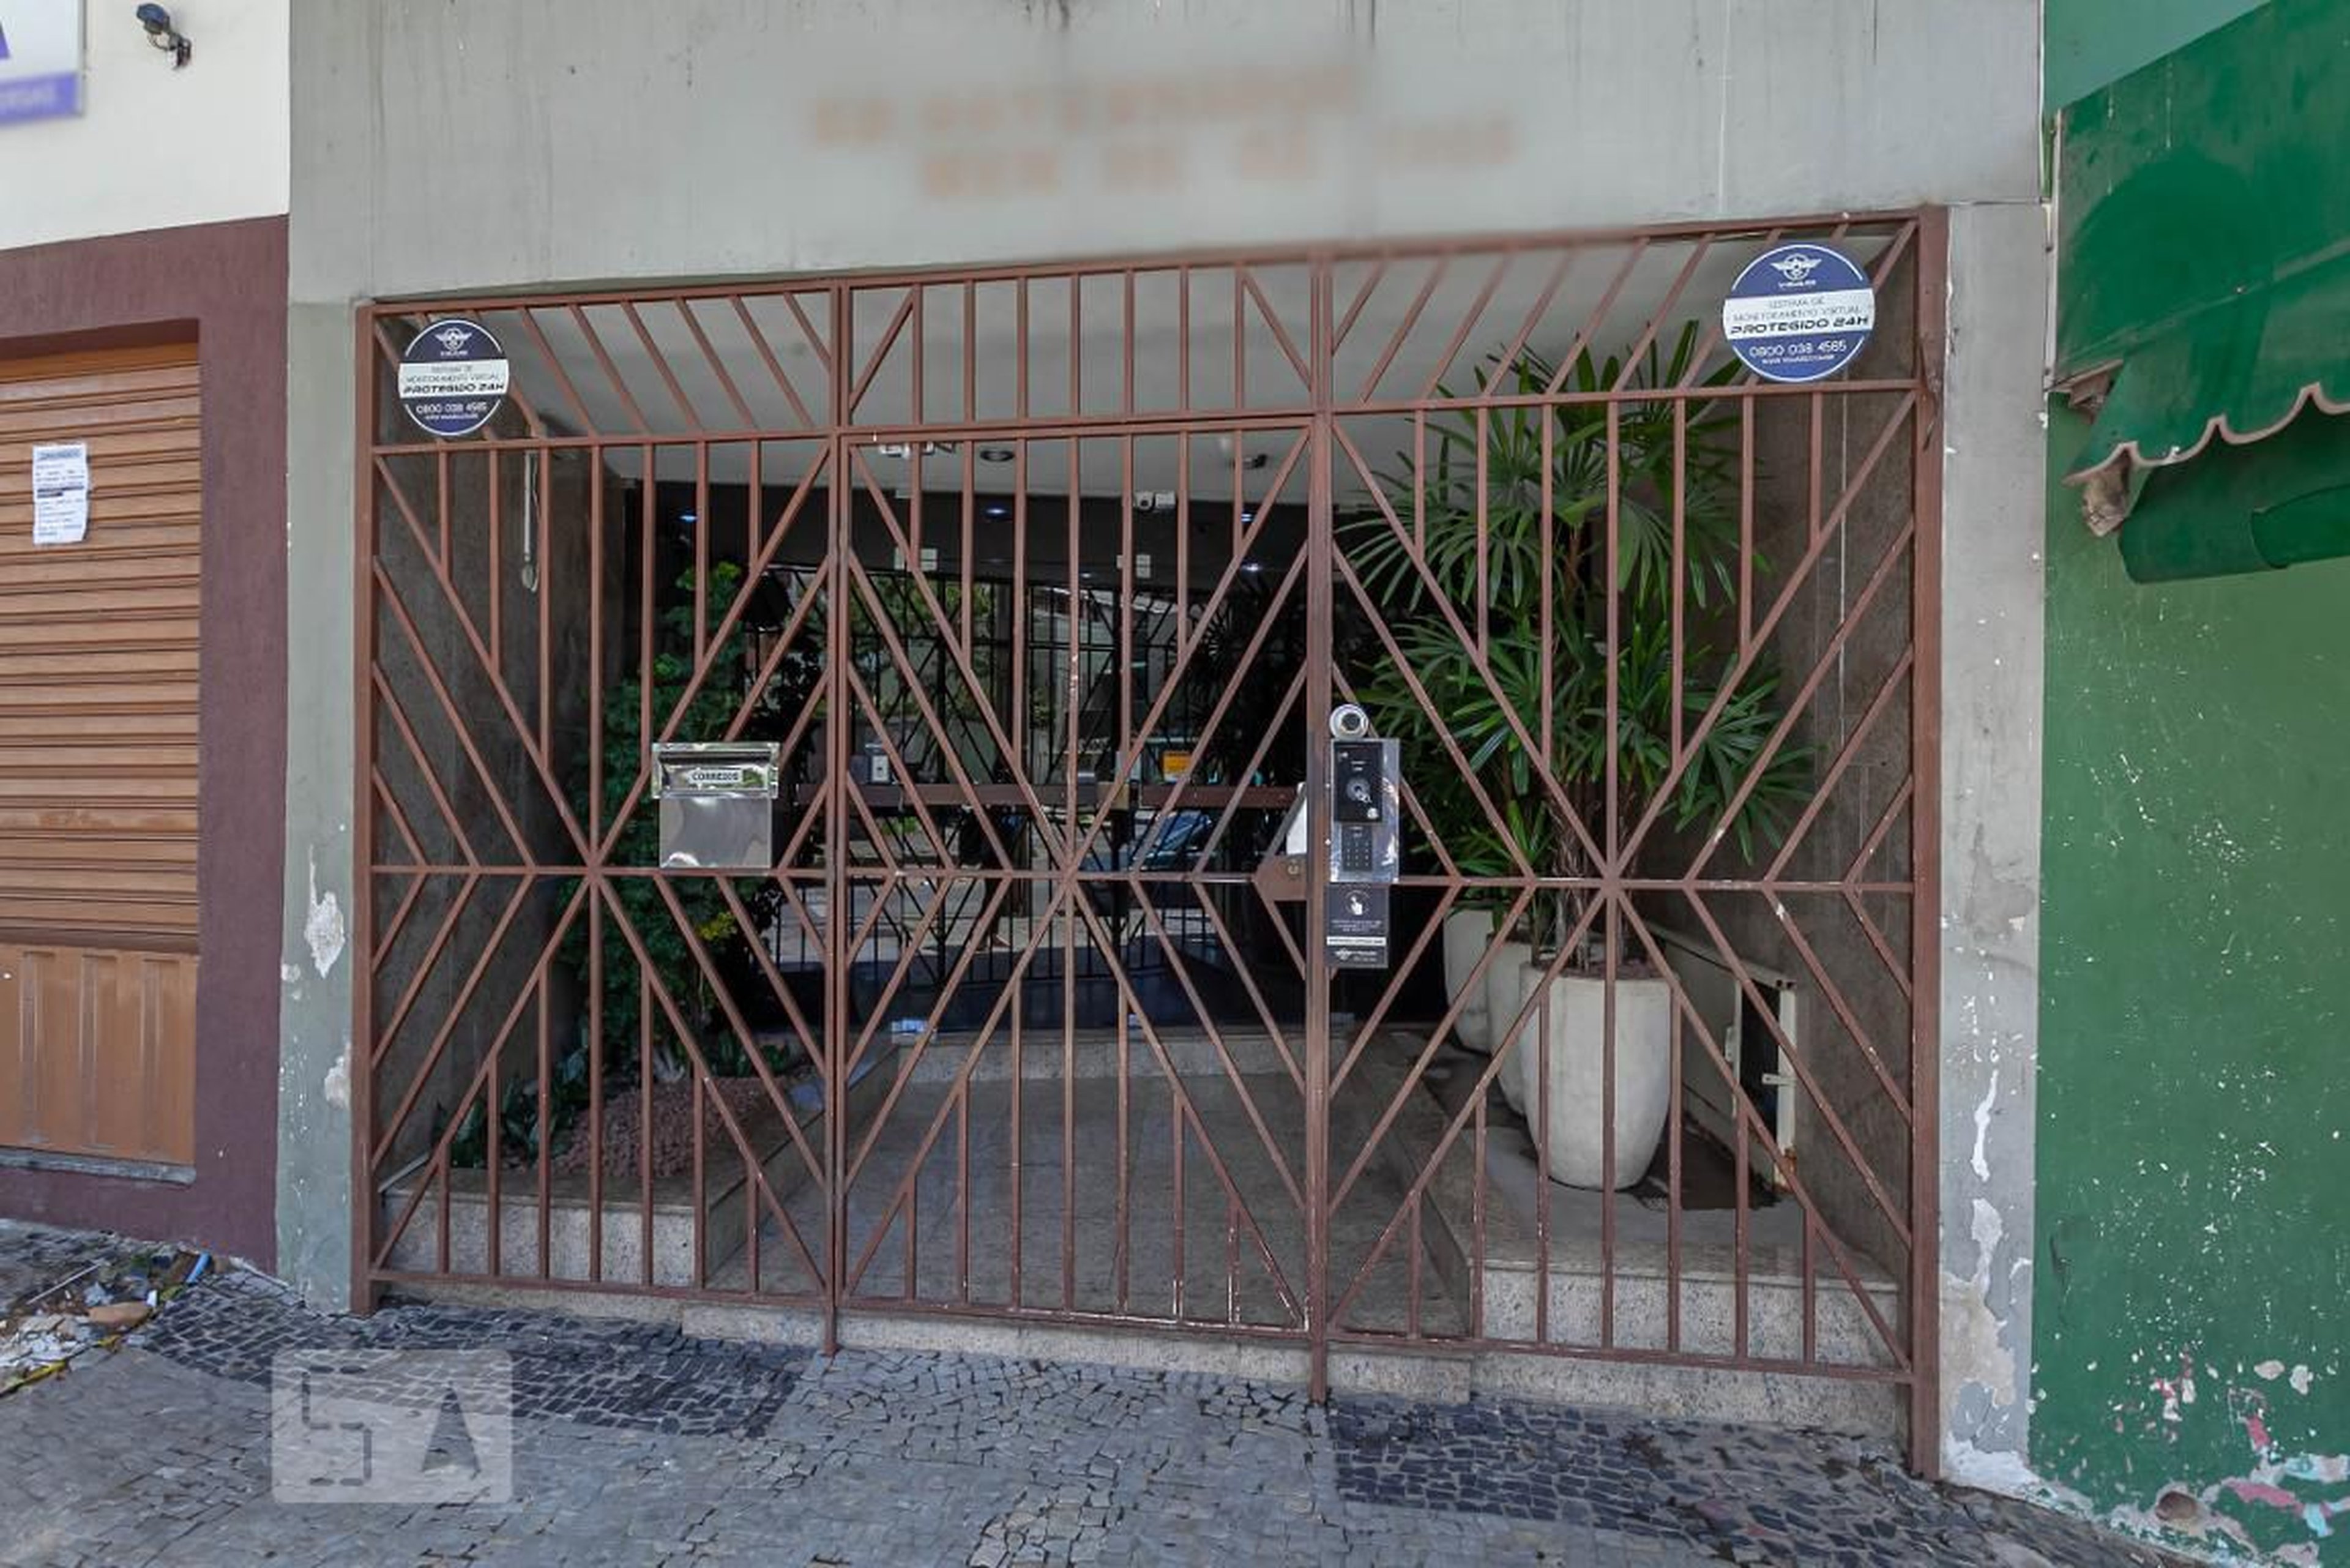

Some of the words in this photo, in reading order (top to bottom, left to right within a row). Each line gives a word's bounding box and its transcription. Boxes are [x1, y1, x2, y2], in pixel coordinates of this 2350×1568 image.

[1731, 318, 1829, 334] PROTEGIDO
[1833, 316, 1868, 327] 24H
[1749, 344, 1785, 358] 0800
[404, 383, 476, 394] PROTEGIDO
